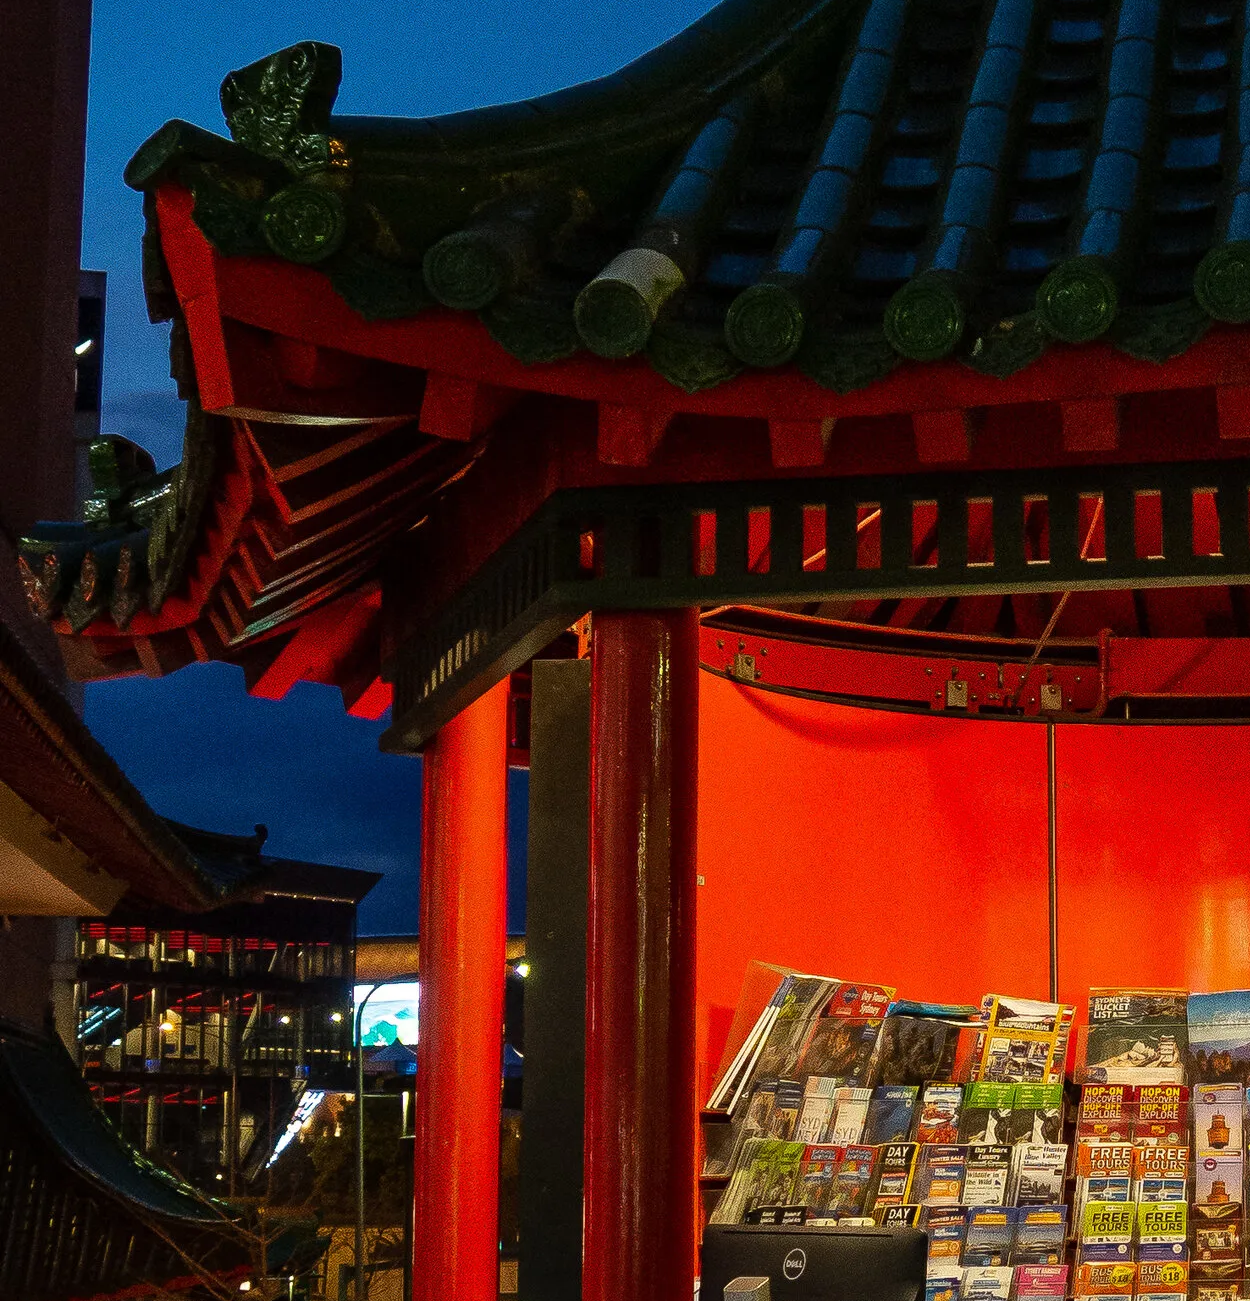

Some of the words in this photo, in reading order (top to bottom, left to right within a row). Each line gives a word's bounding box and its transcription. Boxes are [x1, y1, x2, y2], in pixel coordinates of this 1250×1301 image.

[861, 990, 874, 1002] Day
[872, 992, 889, 1003] Tours
[1094, 996, 1131, 1004] SYDNEY'S
[859, 1003, 881, 1016] Sydney
[1094, 1004, 1130, 1012] BUCKET
[1094, 1011, 1112, 1019] LIST
[1085, 1087, 1124, 1096] HOP-ON
[1140, 1088, 1180, 1097] HOP-ON
[1084, 1096, 1123, 1104] DISCOVER
[1140, 1096, 1180, 1104] DISCOVER
[1084, 1103, 1122, 1112] HOP-OFF
[1140, 1104, 1179, 1112] HOP-OFF
[1082, 1110, 1121, 1119] EXPLORE
[1140, 1111, 1179, 1120] EXPLORE
[802, 1117, 821, 1129] SYD
[836, 1126, 857, 1138] SYD
[887, 1146, 909, 1158] DAY
[988, 1146, 1008, 1154] Tours
[1090, 1148, 1131, 1160] FREE
[1146, 1148, 1187, 1161] FREE
[884, 1158, 906, 1166] TOURS
[1091, 1160, 1130, 1169] TOURS
[1146, 1160, 1185, 1170] TOURS
[888, 1208, 911, 1219] DAY
[1092, 1212, 1130, 1223] FREE
[1146, 1212, 1183, 1223] FREE
[886, 1220, 908, 1228] TOURS
[1092, 1223, 1129, 1232] TOURS
[1146, 1223, 1183, 1232] TOURS
[786, 1260, 803, 1269] DELL
[1140, 1264, 1163, 1274] BUS
[1092, 1268, 1113, 1277] BUS
[1112, 1274, 1129, 1284] $18
[1140, 1274, 1161, 1282] TOUR
[1162, 1274, 1180, 1282] $18
